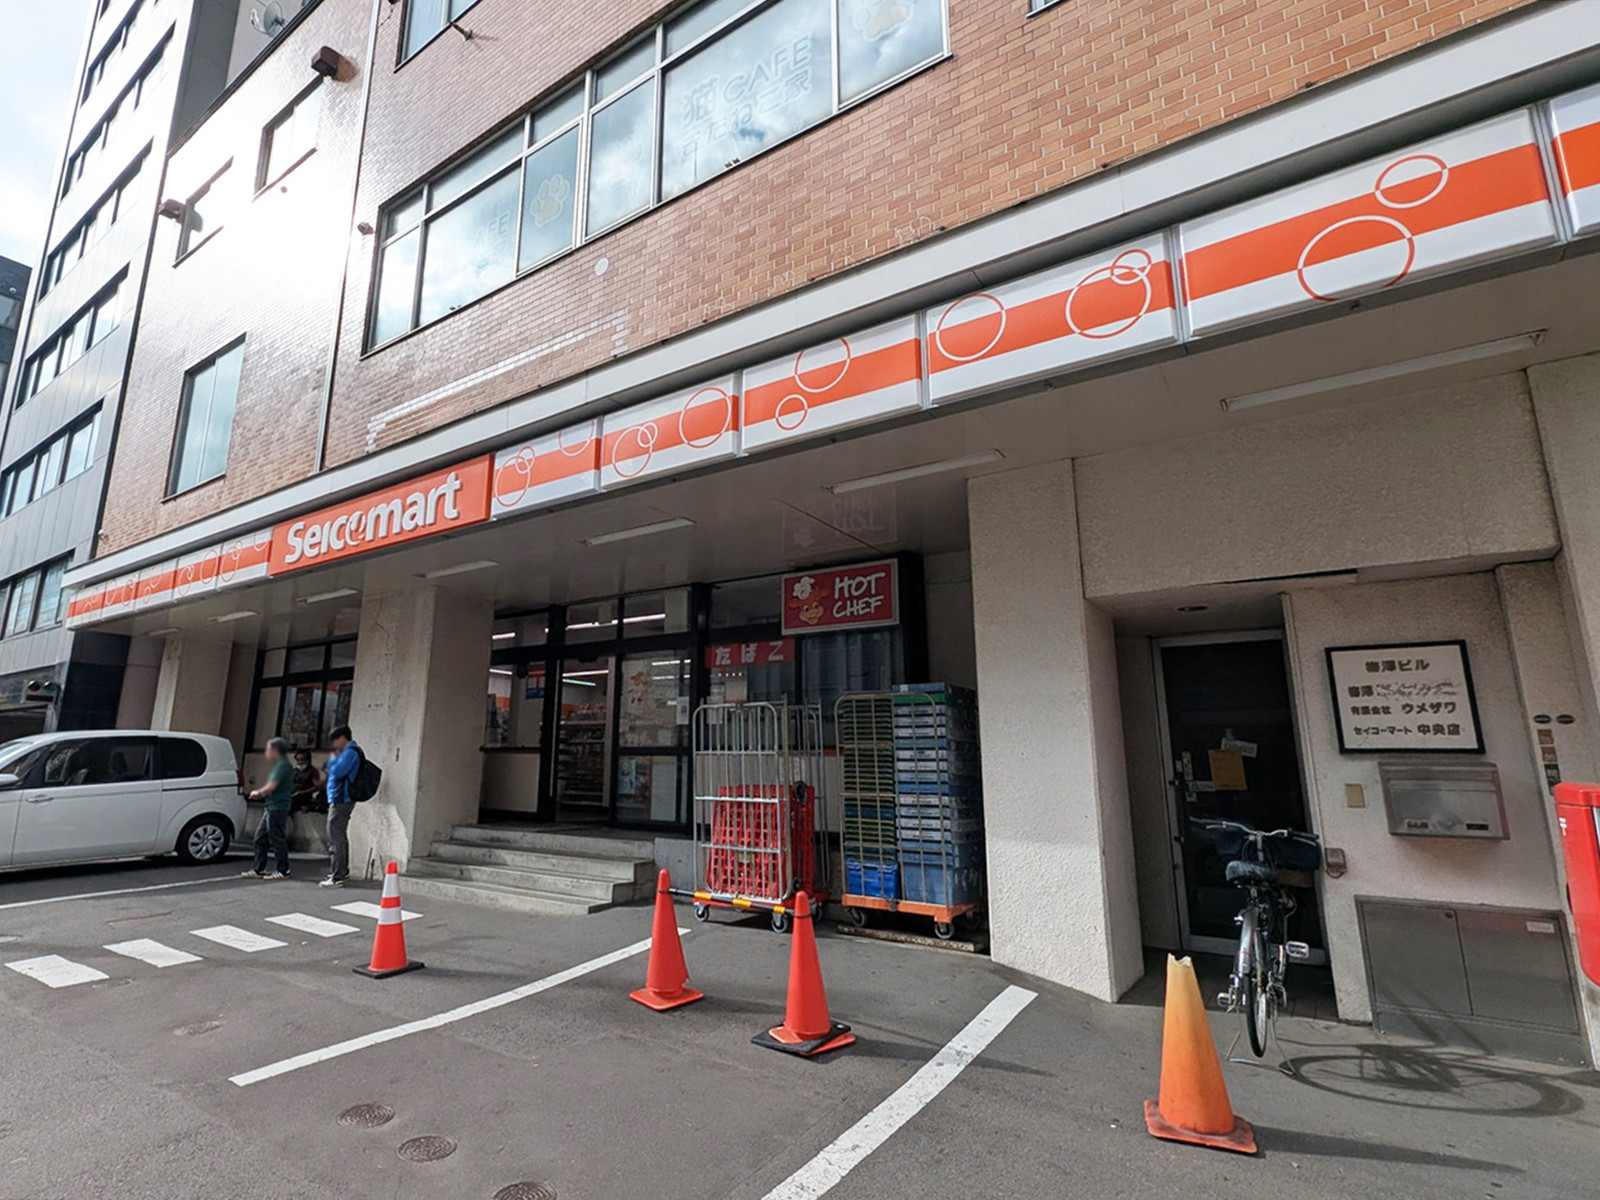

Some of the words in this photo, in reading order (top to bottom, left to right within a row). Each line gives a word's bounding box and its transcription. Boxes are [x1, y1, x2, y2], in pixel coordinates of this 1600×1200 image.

[833, 571, 886, 600] HOT
[832, 595, 884, 619] CHEF
[714, 641, 785, 666] たばこ
[1350, 705, 1392, 716] 有限会社
[1401, 701, 1457, 715] ウメザワ
[1353, 726, 1413, 736] セイコーマート
[1417, 723, 1461, 736] 中央店
